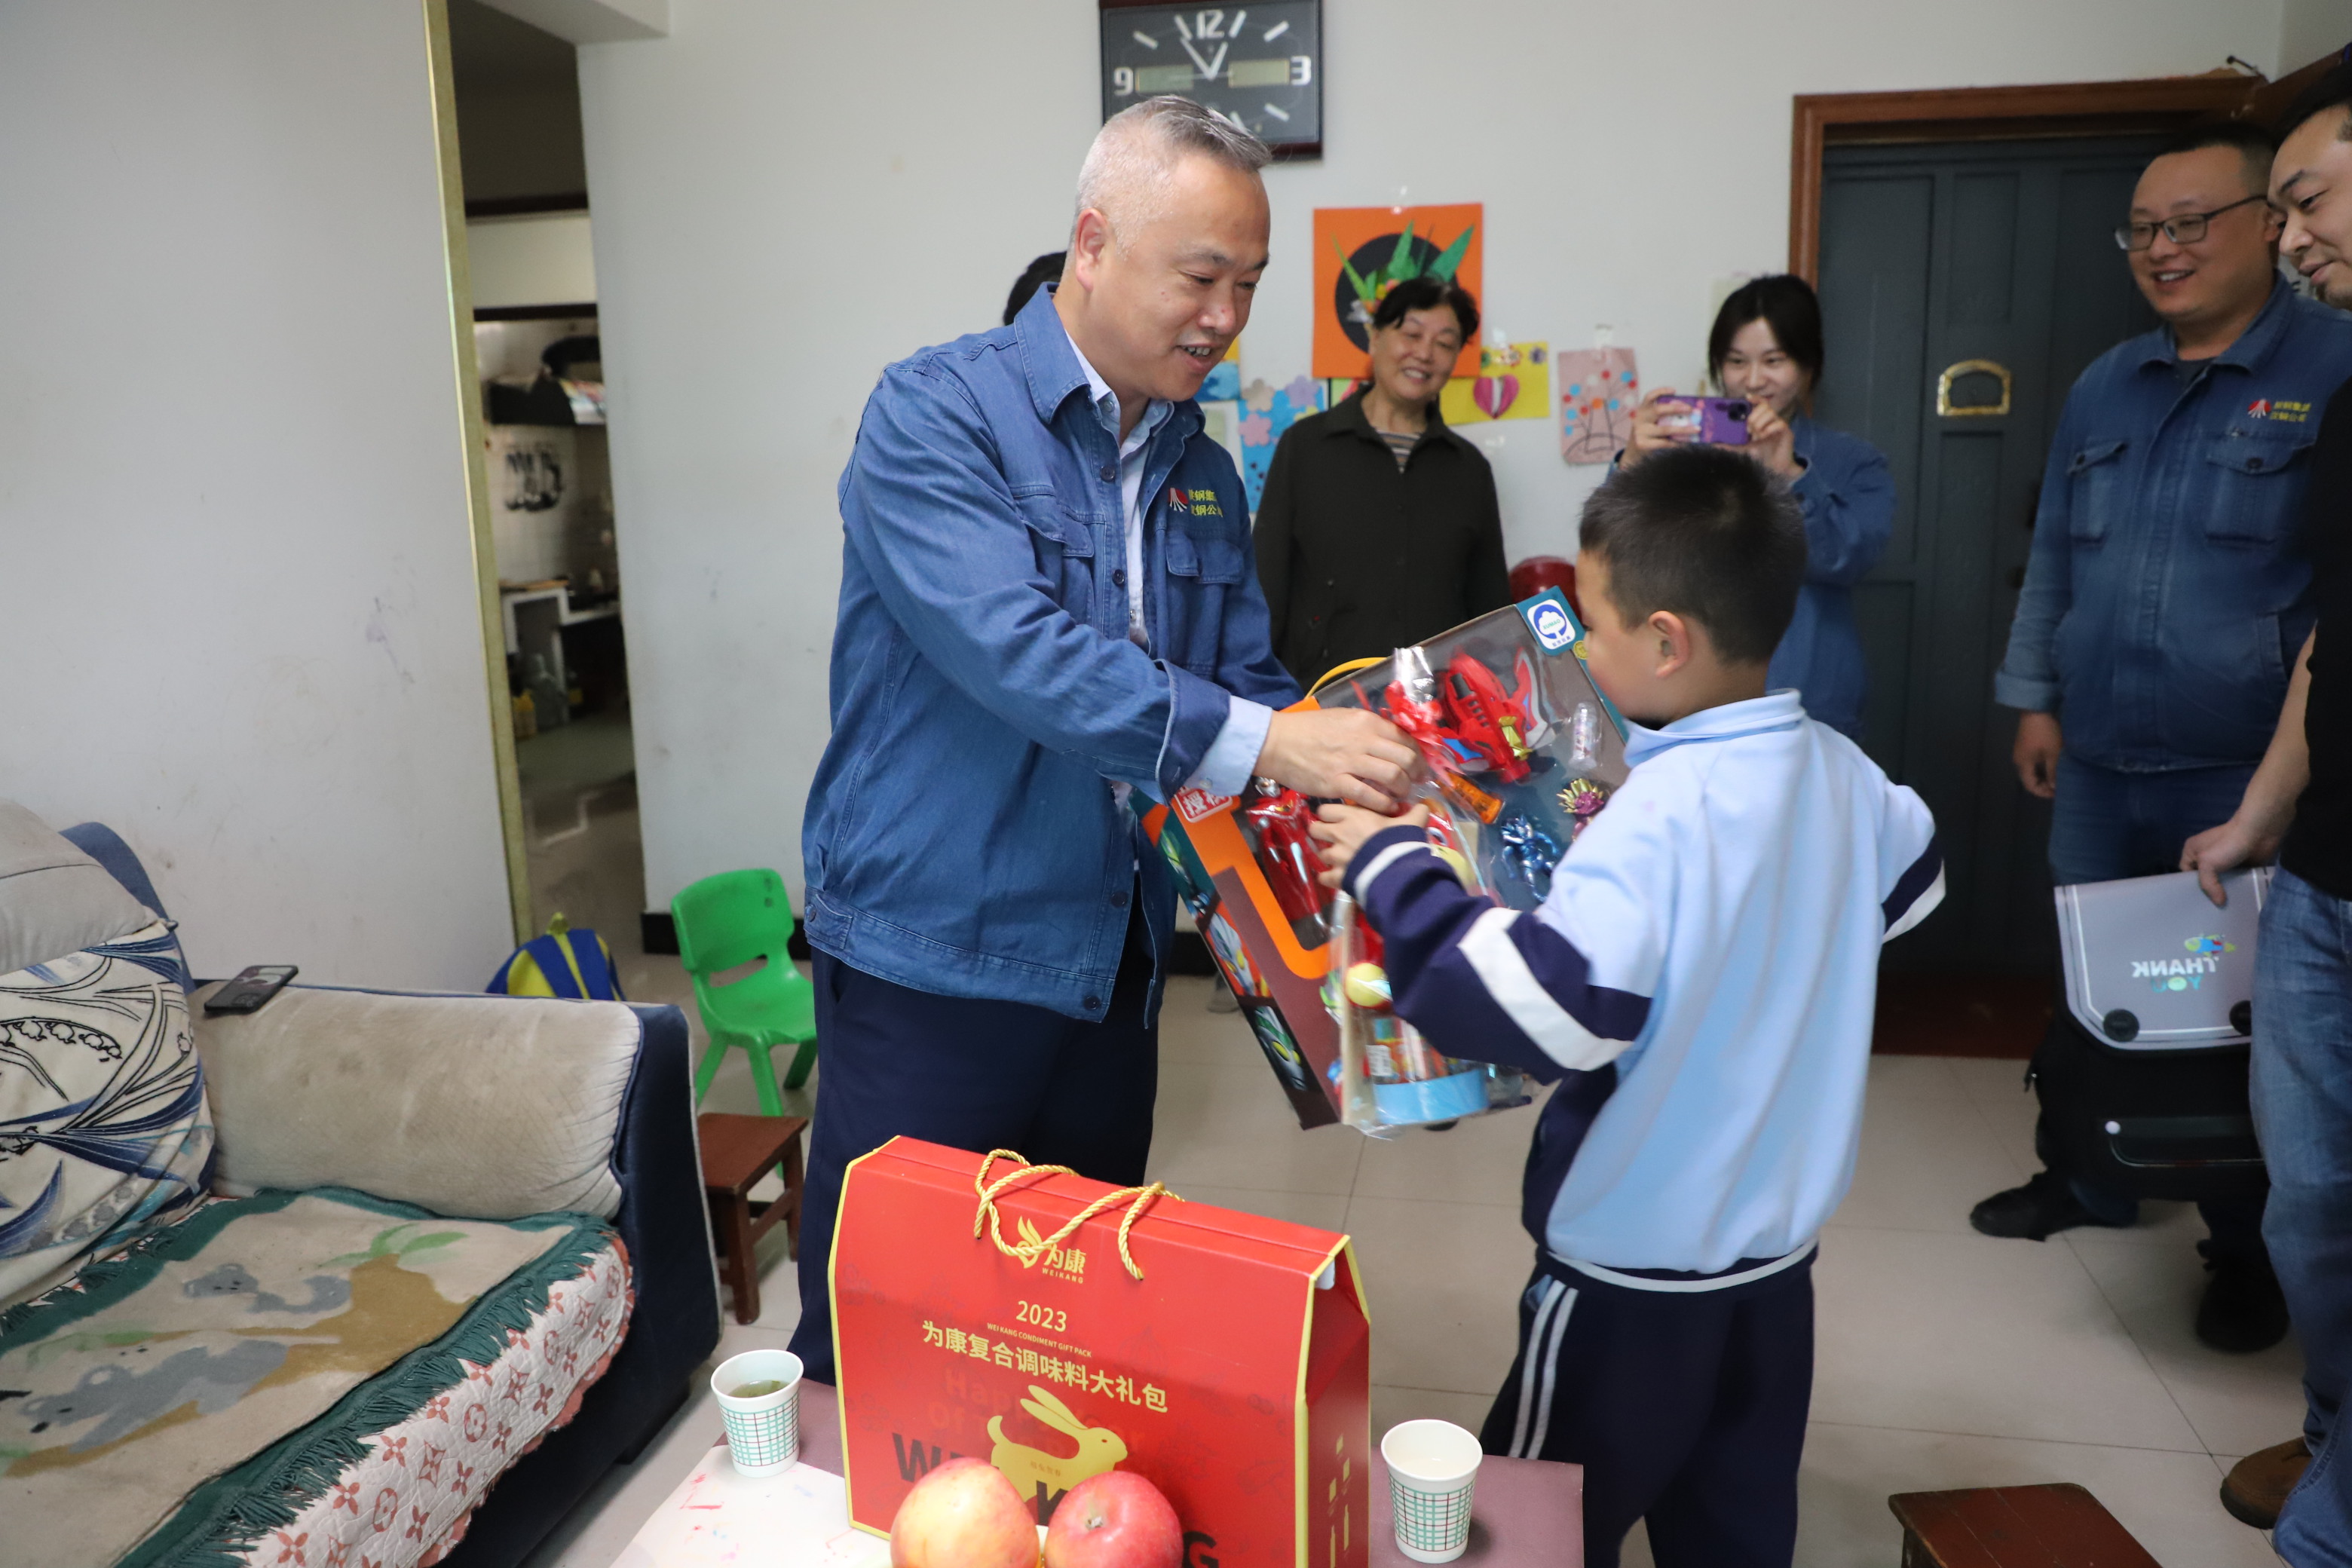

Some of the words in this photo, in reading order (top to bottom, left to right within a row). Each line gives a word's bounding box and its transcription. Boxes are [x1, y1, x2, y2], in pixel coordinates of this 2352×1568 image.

[1196, 9, 1225, 38] 12
[1113, 66, 1134, 96] 9
[1290, 55, 1312, 86] 3
[1043, 1243, 1087, 1274] 为康
[1042, 1267, 1084, 1284] WEIKANG
[1016, 1300, 1067, 1332] 2023
[987, 1322, 1000, 1332] WEI
[1000, 1325, 1018, 1337] KANG
[1018, 1331, 1058, 1348] CONDIMENT
[1058, 1343, 1074, 1352] GIFT
[1074, 1346, 1092, 1358] PACK
[922, 1320, 1168, 1413] 为康复合调味料大礼包
